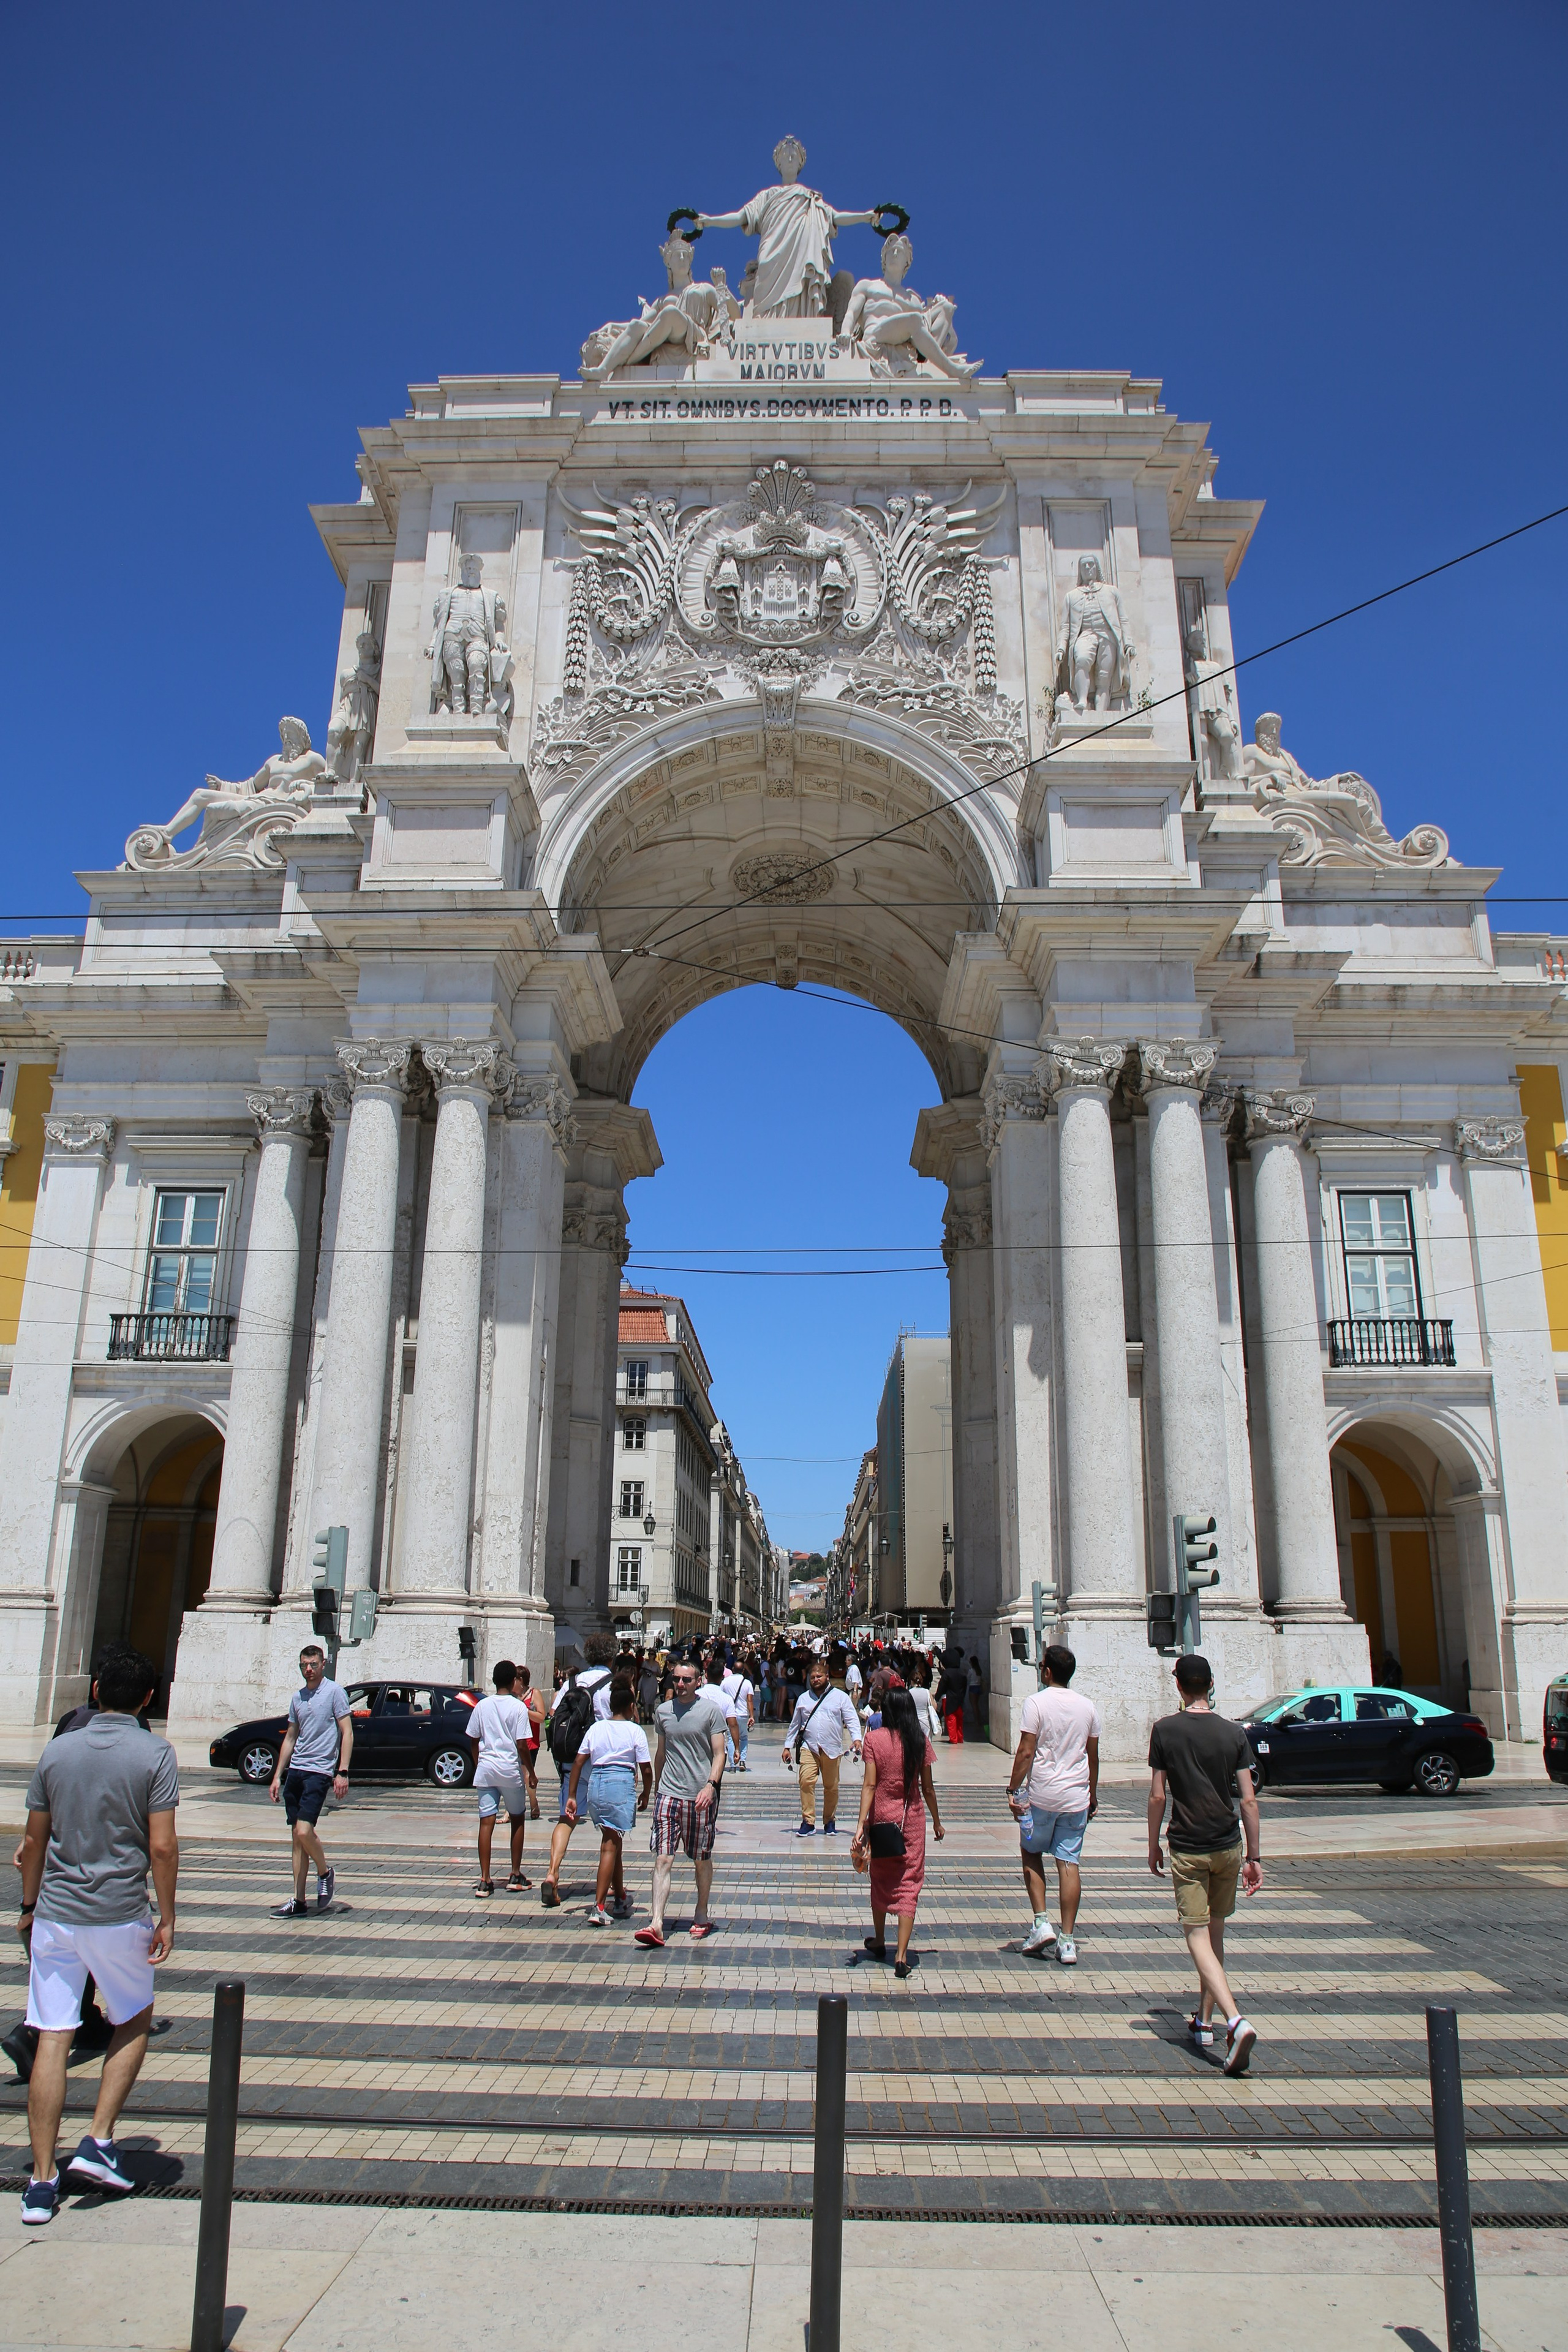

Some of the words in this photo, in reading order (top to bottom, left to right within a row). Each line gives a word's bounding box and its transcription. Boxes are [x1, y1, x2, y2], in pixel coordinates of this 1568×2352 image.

[727, 342, 840, 360] VIRTVTIBVS
[740, 363, 825, 380] MAIORVM
[608, 401, 635, 419] VT.
[640, 401, 672, 418] SIT.
